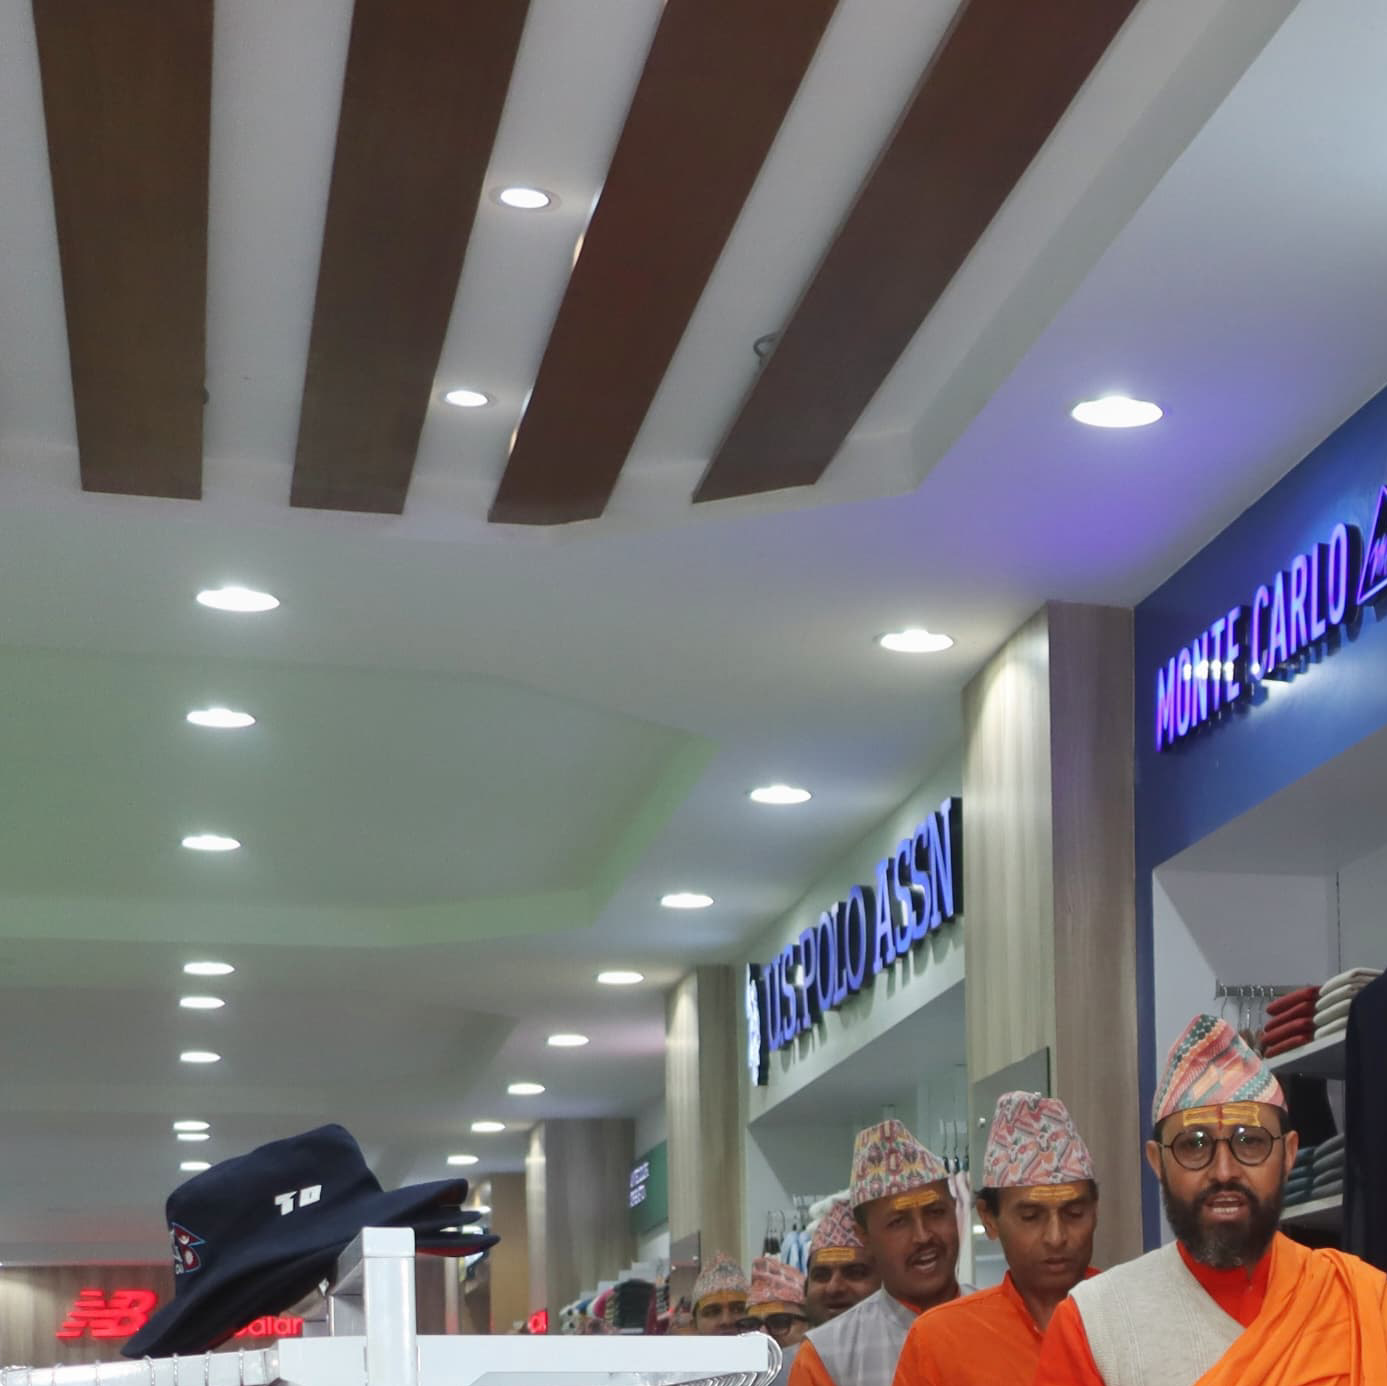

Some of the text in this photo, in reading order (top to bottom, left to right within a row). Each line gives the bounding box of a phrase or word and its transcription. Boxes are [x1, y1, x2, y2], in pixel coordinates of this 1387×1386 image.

[1156, 522, 1350, 752] MONTE CARLO
[798, 884, 868, 1030] POLO
